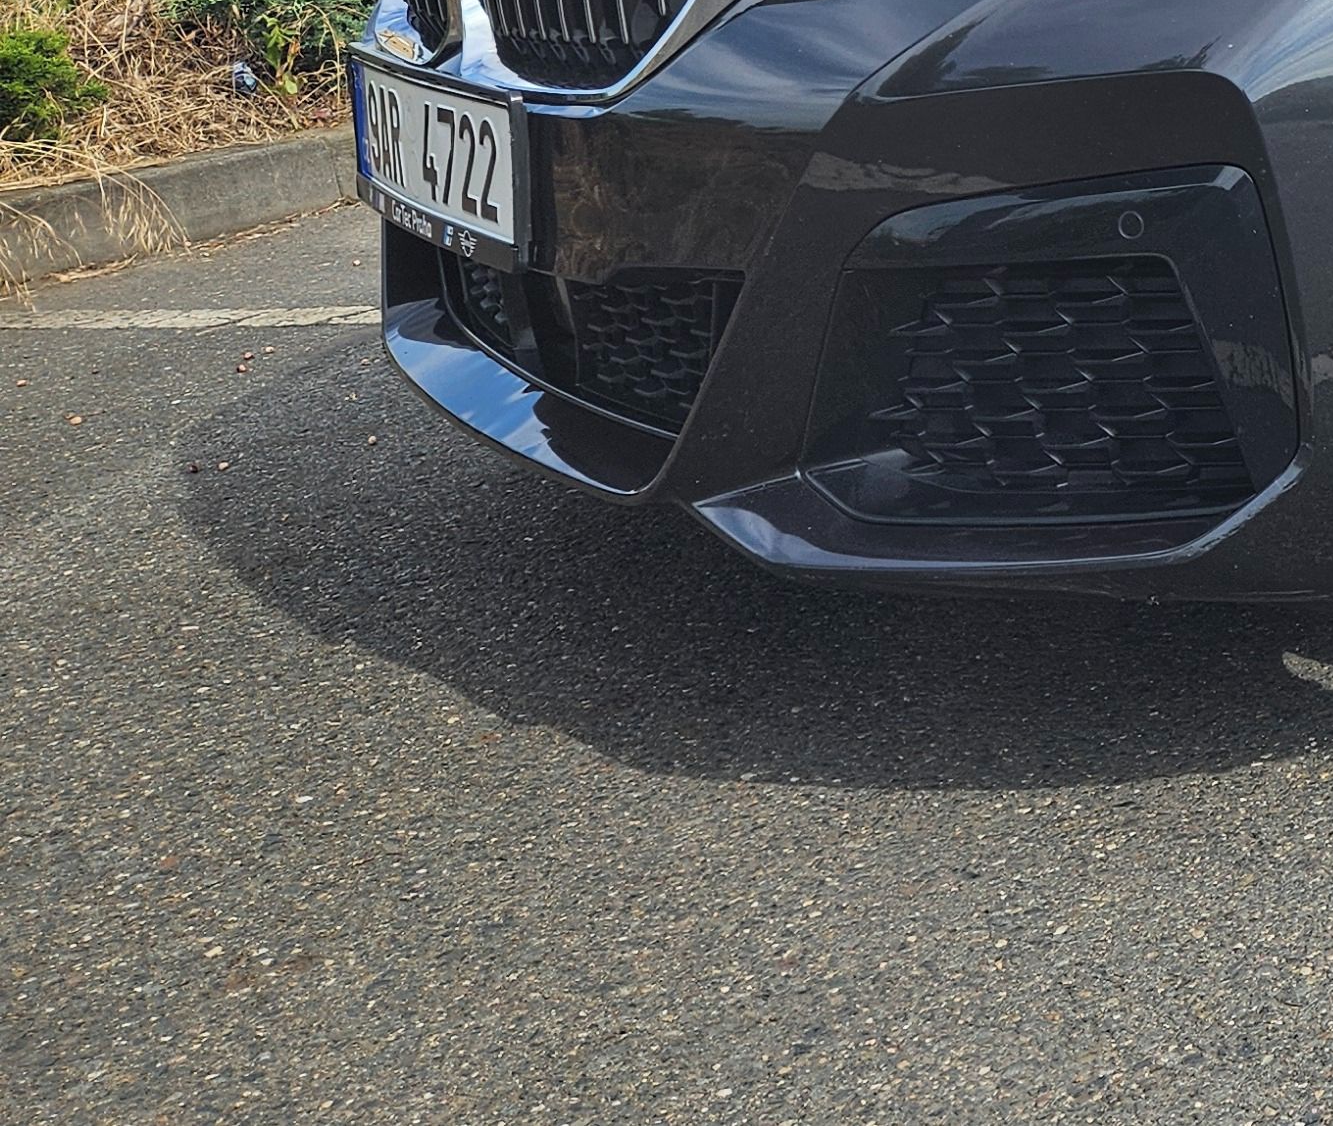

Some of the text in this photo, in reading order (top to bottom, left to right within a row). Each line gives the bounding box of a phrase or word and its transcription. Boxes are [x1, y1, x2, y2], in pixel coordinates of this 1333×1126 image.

[367, 80, 500, 224] 9AR 4722
[411, 210, 433, 239] Praha
